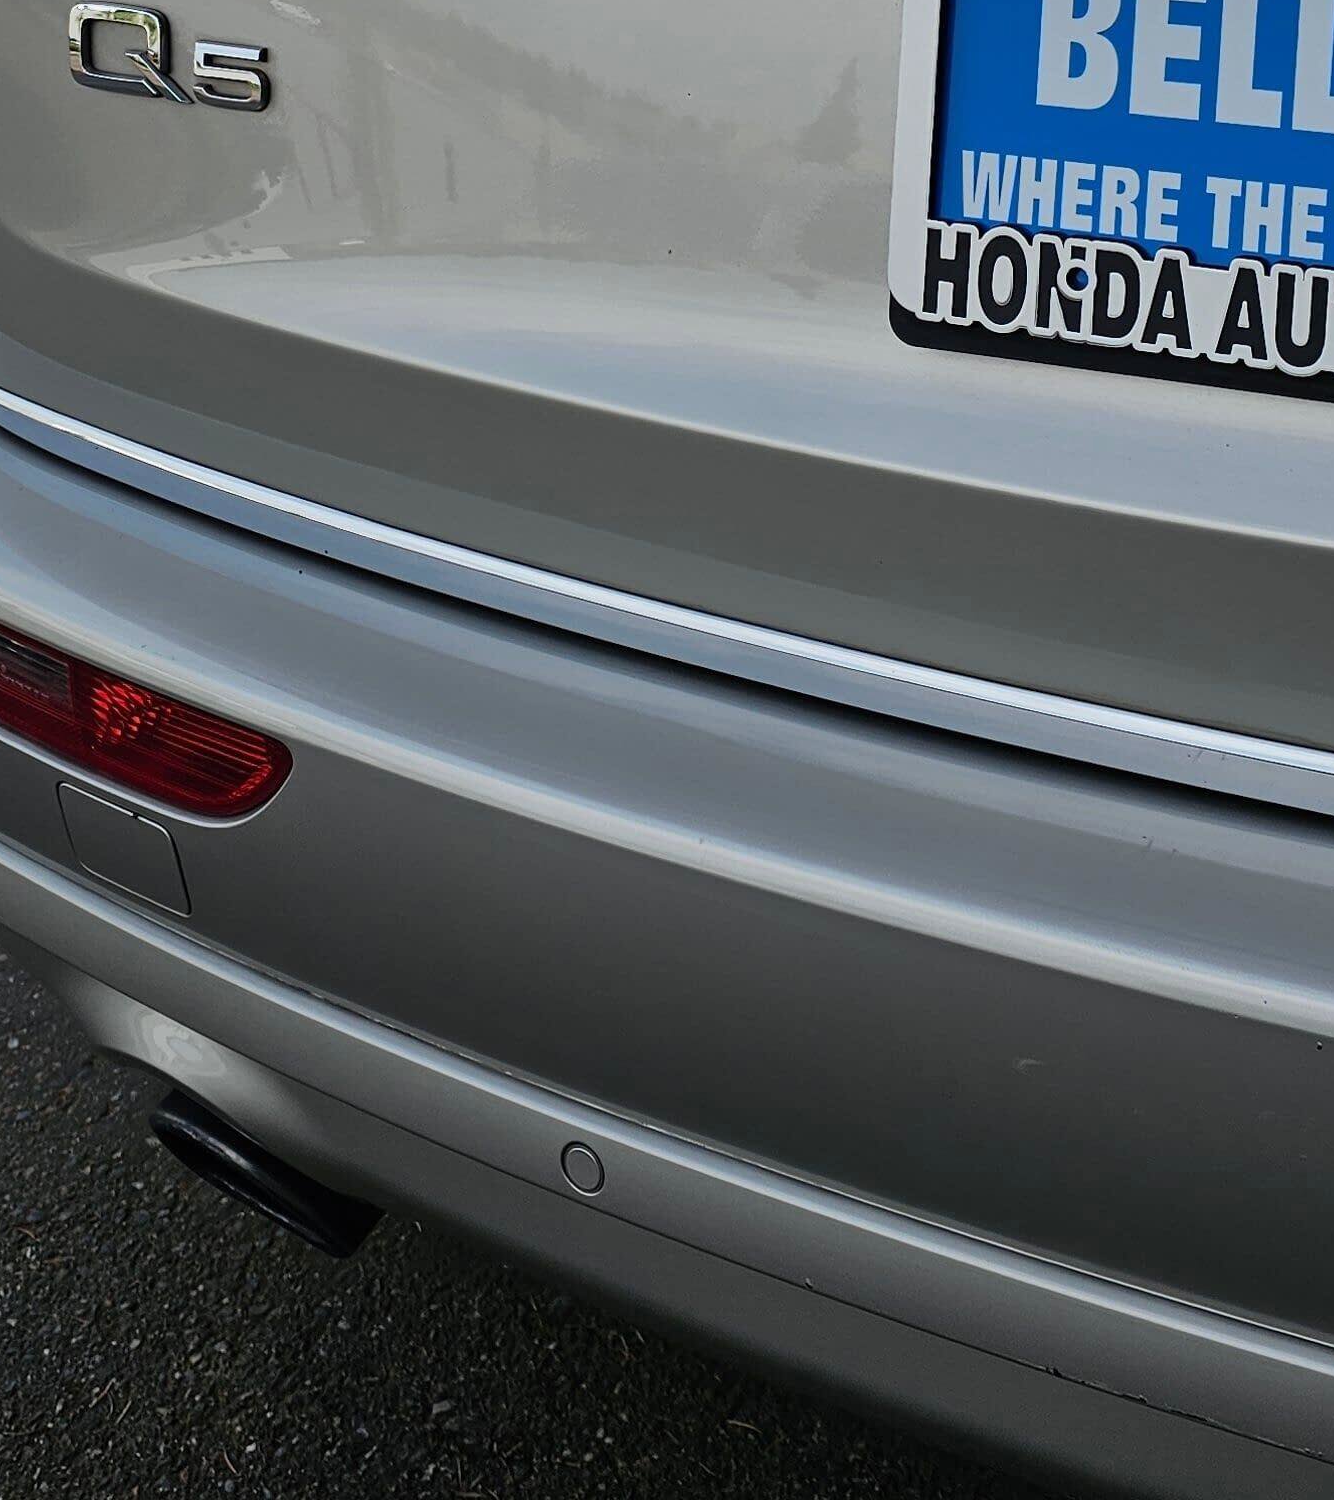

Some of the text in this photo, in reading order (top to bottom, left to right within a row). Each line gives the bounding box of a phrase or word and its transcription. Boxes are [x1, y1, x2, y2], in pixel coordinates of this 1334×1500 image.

[68, 0, 271, 112] Q5
[961, 150, 1182, 244] WHERE
[1206, 176, 1328, 261] THE
[922, 227, 1192, 351] HONDA
